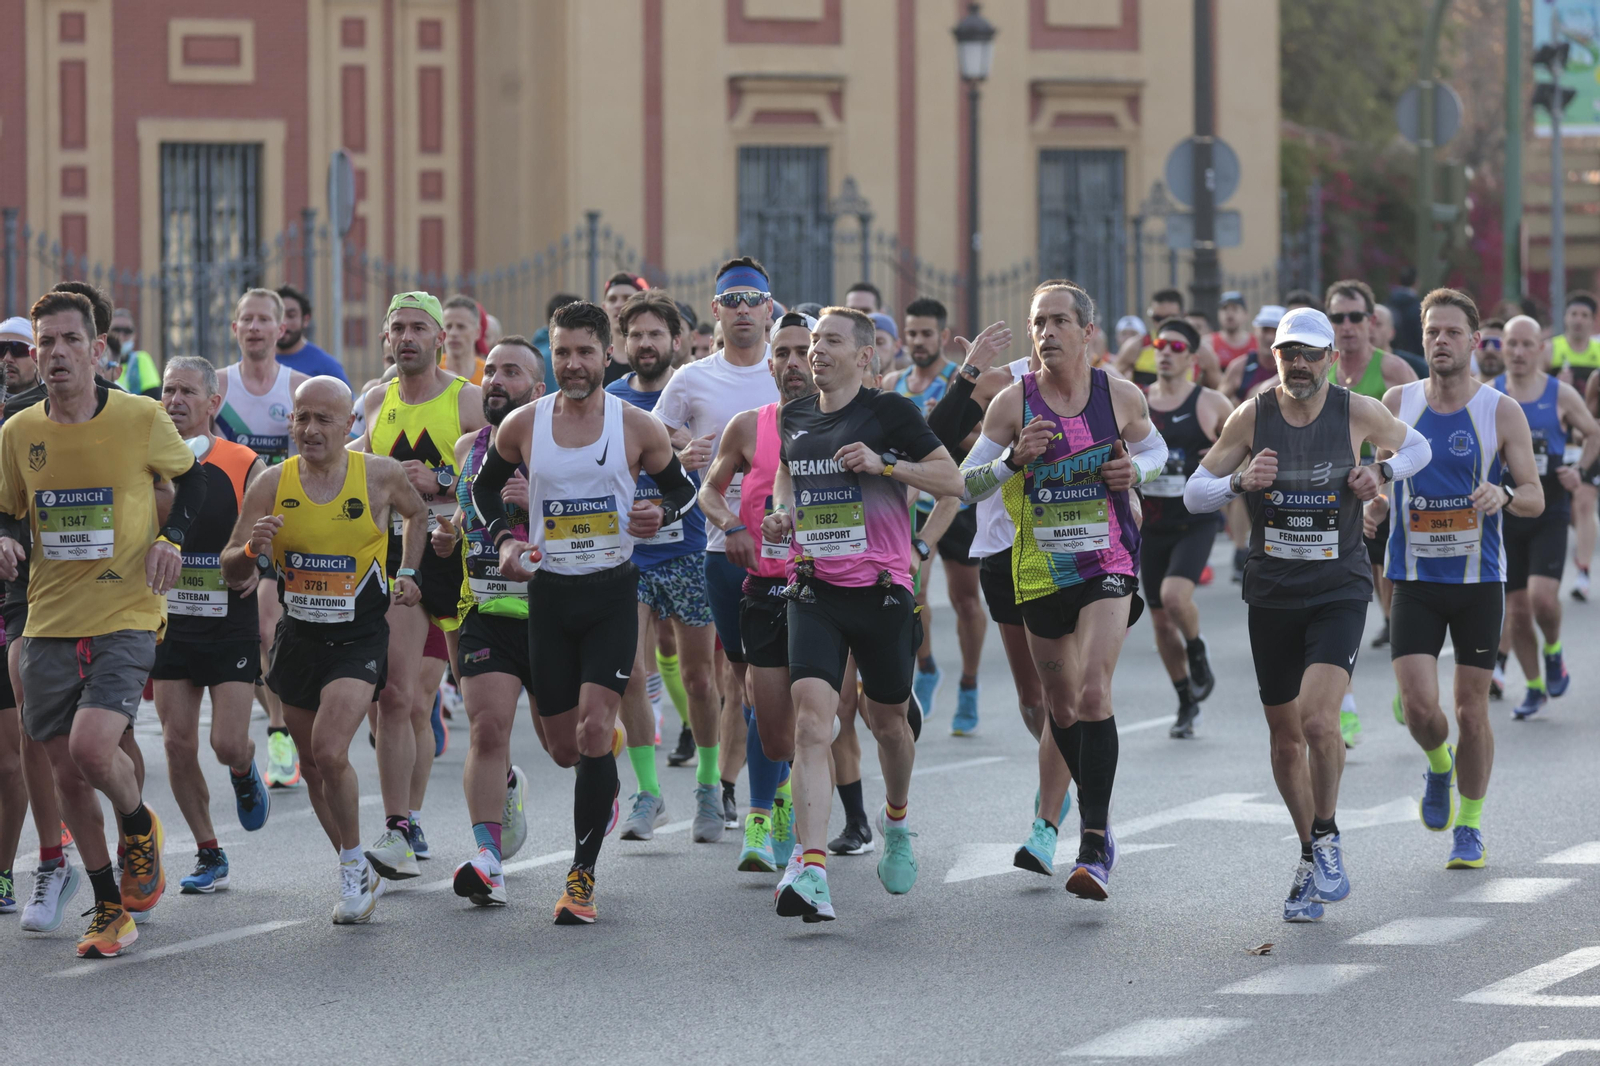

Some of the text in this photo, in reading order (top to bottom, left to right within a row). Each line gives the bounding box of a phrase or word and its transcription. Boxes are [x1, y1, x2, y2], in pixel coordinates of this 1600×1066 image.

[250, 438, 282, 446] ZURICH
[59, 492, 103, 503] ZURICH
[634, 488, 662, 498] ZURIC
[812, 490, 852, 502] ZURICH
[1055, 488, 1097, 500] ZURICH
[1286, 495, 1331, 504] ZURICH
[1429, 498, 1468, 508] ZURICH
[566, 501, 608, 513] ZURICH
[61, 516, 87, 527] 1347
[814, 513, 838, 525] 1582
[1057, 510, 1081, 522] 1581
[1287, 516, 1313, 527] 3089
[572, 524, 590, 534] 466
[1430, 518, 1453, 529] 3947
[806, 530, 851, 542] LOLOSPORT
[1054, 527, 1089, 538] MANUEL
[1279, 532, 1323, 542] FERNANDO
[59, 534, 91, 544] MIGUEL
[1430, 534, 1458, 543] DANIEL
[571, 540, 594, 549] DAVID
[182, 556, 220, 566] ZURICH
[304, 558, 347, 569] ZURICH
[182, 576, 204, 587] 1405
[304, 580, 328, 592] 3781
[486, 582, 507, 591] APON
[178, 592, 210, 601] ESTEBAN
[290, 595, 346, 607] JOSÉ ANTONIO
